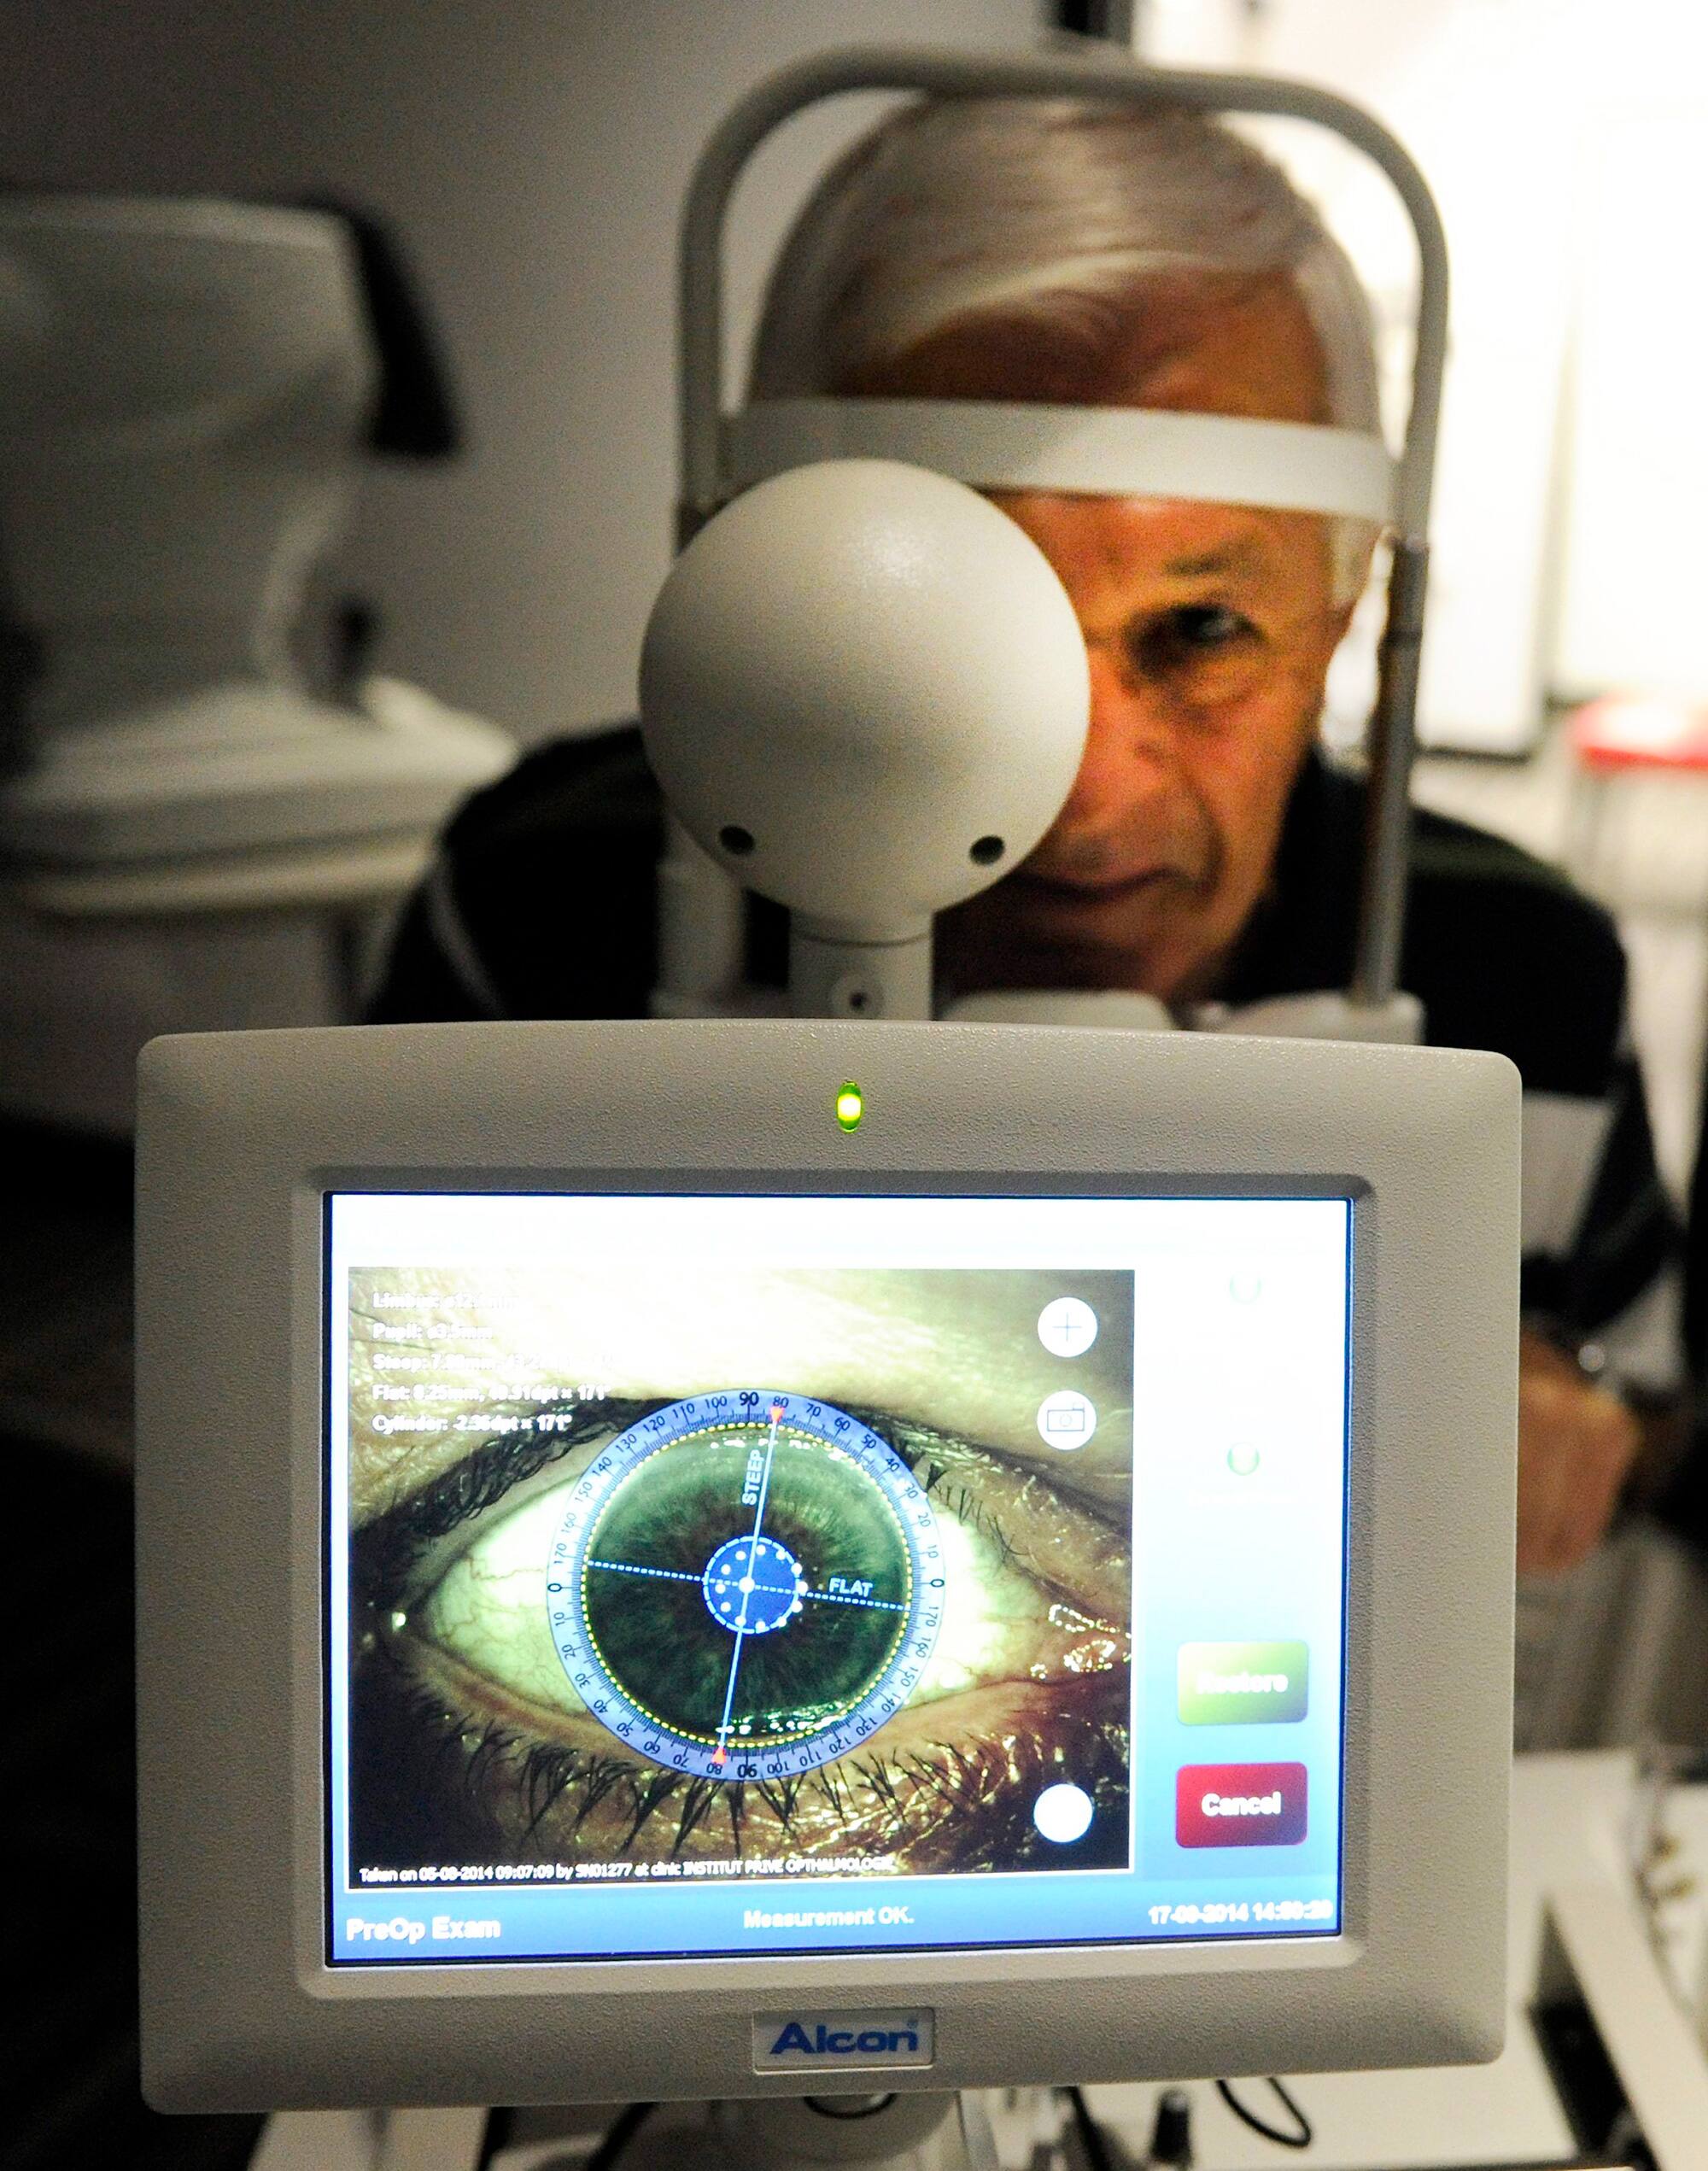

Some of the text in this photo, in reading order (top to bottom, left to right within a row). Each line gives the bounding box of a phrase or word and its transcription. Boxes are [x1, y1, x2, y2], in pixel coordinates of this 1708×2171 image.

[372, 1323, 423, 1342] Pupil:
[372, 1354, 424, 1372] Steep:
[372, 1384, 410, 1400] Flat:
[740, 1392, 759, 1406] 90
[705, 1396, 727, 1408] 100
[773, 1397, 789, 1408] 80
[806, 1403, 821, 1417] 70
[673, 1403, 694, 1418] 110
[372, 1415, 448, 1434] Cylinder:
[643, 1416, 665, 1432] 120
[834, 1418, 850, 1431] 60
[616, 1434, 636, 1452] 130
[861, 1435, 876, 1448] 50
[592, 1457, 612, 1476] 140
[886, 1457, 899, 1472] 40
[742, 1450, 764, 1505] STEEP
[575, 1482, 592, 1502] 150
[904, 1483, 918, 1499] 30
[562, 1513, 576, 1533] 160
[918, 1513, 931, 1527] 20
[554, 1543, 566, 1563] 170
[927, 1545, 939, 1558] 10
[829, 1578, 873, 1597] FLAT
[553, 1612, 564, 1626] 10
[926, 1606, 939, 1627] 170
[561, 1644, 576, 1659] 20
[915, 1637, 931, 1658] 160
[575, 1674, 590, 1688] 30
[901, 1666, 918, 1687] 150
[594, 1700, 608, 1714] 40
[881, 1694, 901, 1712] 140
[617, 1723, 633, 1736] 50
[856, 1717, 878, 1736] 130
[644, 1741, 660, 1755] 60
[829, 1738, 851, 1753] 120
[674, 1754, 689, 1768] 70
[799, 1752, 822, 1766] 110
[706, 1763, 722, 1775] 80
[737, 1764, 757, 1777] 90
[767, 1762, 790, 1774] 100
[1201, 1791, 1282, 1817] Cancel
[359, 1868, 399, 1882] Taken
[400, 1870, 418, 1881] on
[556, 1863, 573, 1880] by
[635, 1864, 649, 1876] at
[651, 1861, 681, 1875] clinic
[682, 1860, 743, 1875] INSTITUT
[743, 1906, 915, 1928] Measurement OK.
[346, 1915, 500, 1944] PreOp Exam
[769, 2022, 918, 2054] Alcon
